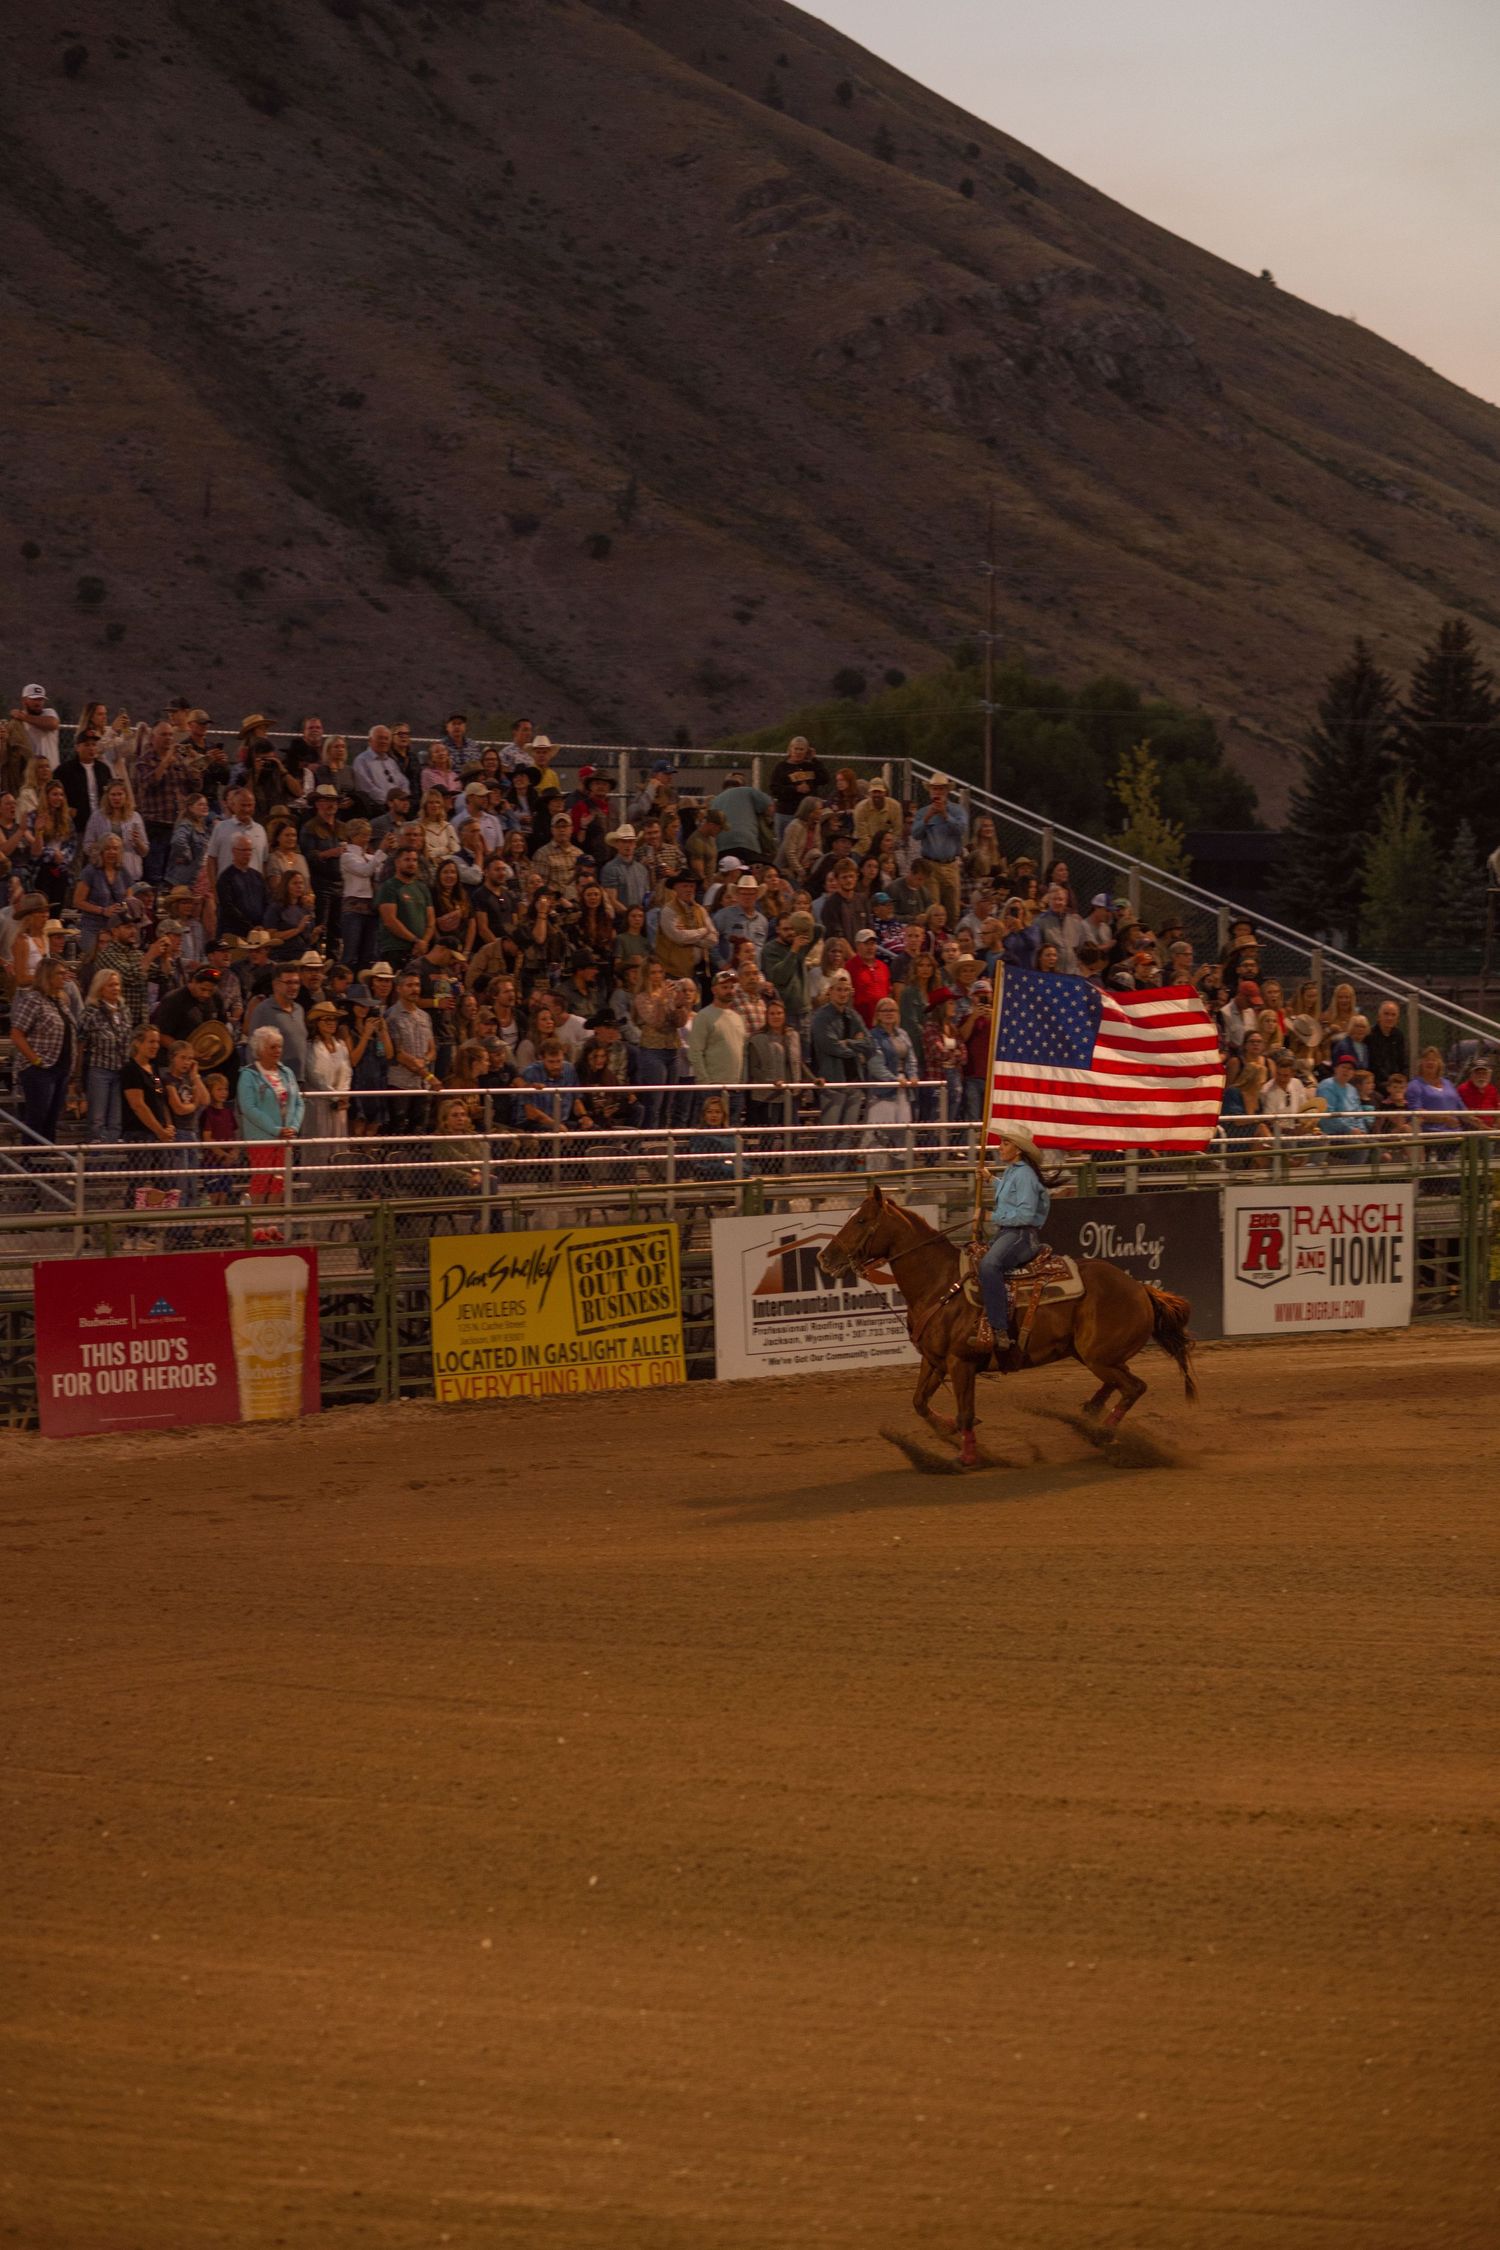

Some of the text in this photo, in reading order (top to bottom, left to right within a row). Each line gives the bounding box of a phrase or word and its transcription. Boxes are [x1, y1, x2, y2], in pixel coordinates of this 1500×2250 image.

[1248, 1213, 1281, 1228] BIG
[1292, 1203, 1403, 1235] RANCH
[575, 1239, 666, 1274] GOING
[1079, 1221, 1163, 1270] Minky
[1242, 1228, 1284, 1271] R
[1296, 1235, 1404, 1287] AND HOME
[578, 1262, 668, 1299] OUT OF
[456, 1299, 528, 1321] JEWELERS
[581, 1286, 671, 1324] BUSINESS
[752, 1295, 841, 1318] Intermountain
[843, 1291, 887, 1311] Roofing
[753, 1322, 808, 1336] Professional
[811, 1320, 845, 1332] Roofing
[805, 1331, 844, 1345] Wyoming
[79, 1336, 189, 1369] THIS BUD'S
[435, 1333, 681, 1374] LOCATED IN GASLIGHT ALLEY
[794, 1352, 809, 1364] Got
[809, 1351, 824, 1363] Our
[826, 1347, 869, 1362] Community
[52, 1371, 93, 1398] FOR
[96, 1369, 139, 1395] OUR
[142, 1362, 217, 1391] HEROES
[439, 1358, 682, 1402] EVERYTHING MUST GO!
